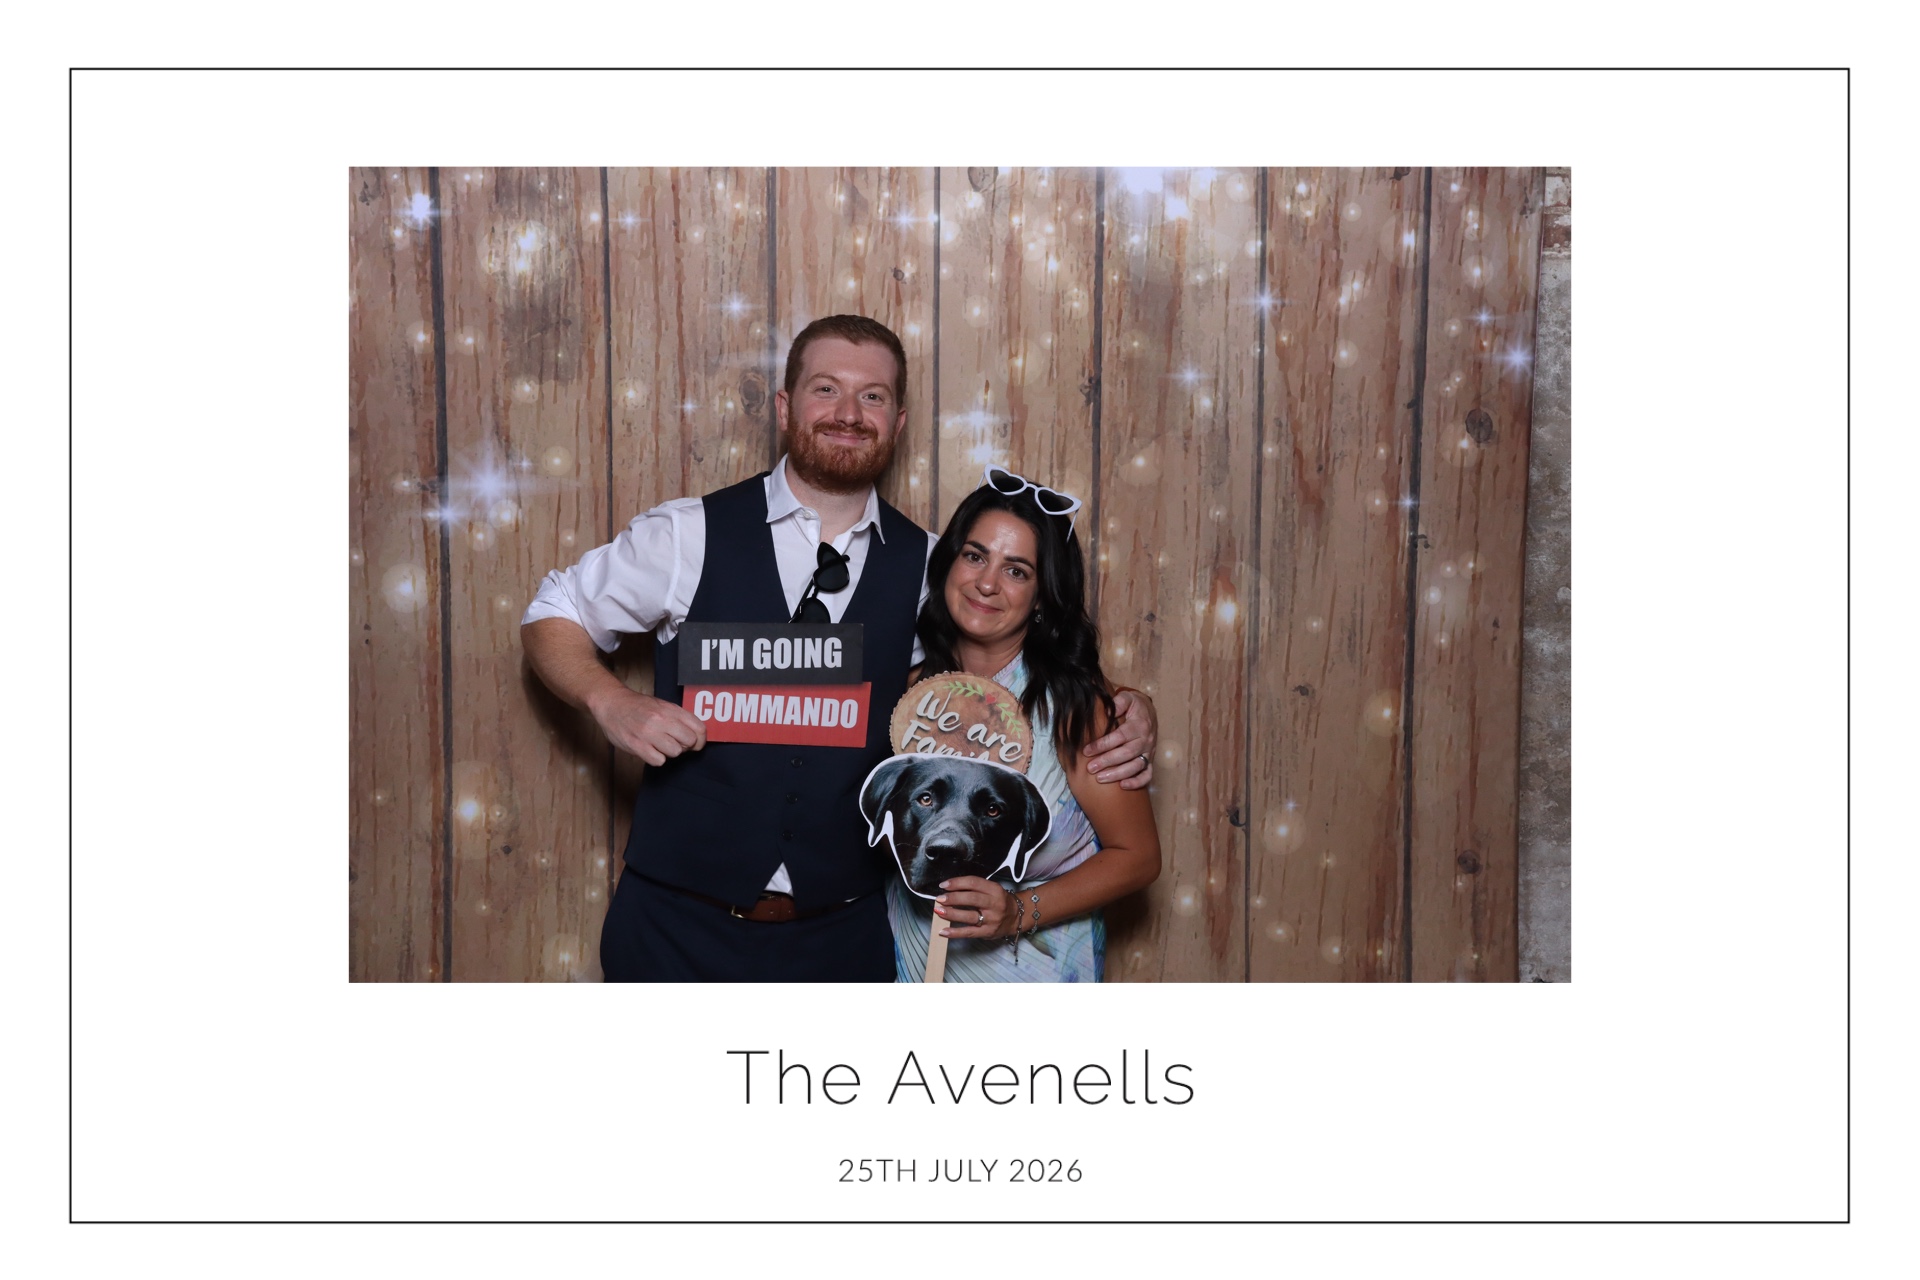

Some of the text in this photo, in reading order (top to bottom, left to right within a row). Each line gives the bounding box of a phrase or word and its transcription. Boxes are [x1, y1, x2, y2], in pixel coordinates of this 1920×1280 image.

[701, 637, 843, 671] I'M GOING
[693, 690, 859, 729] COMMANDO
[916, 690, 1025, 763] We are
